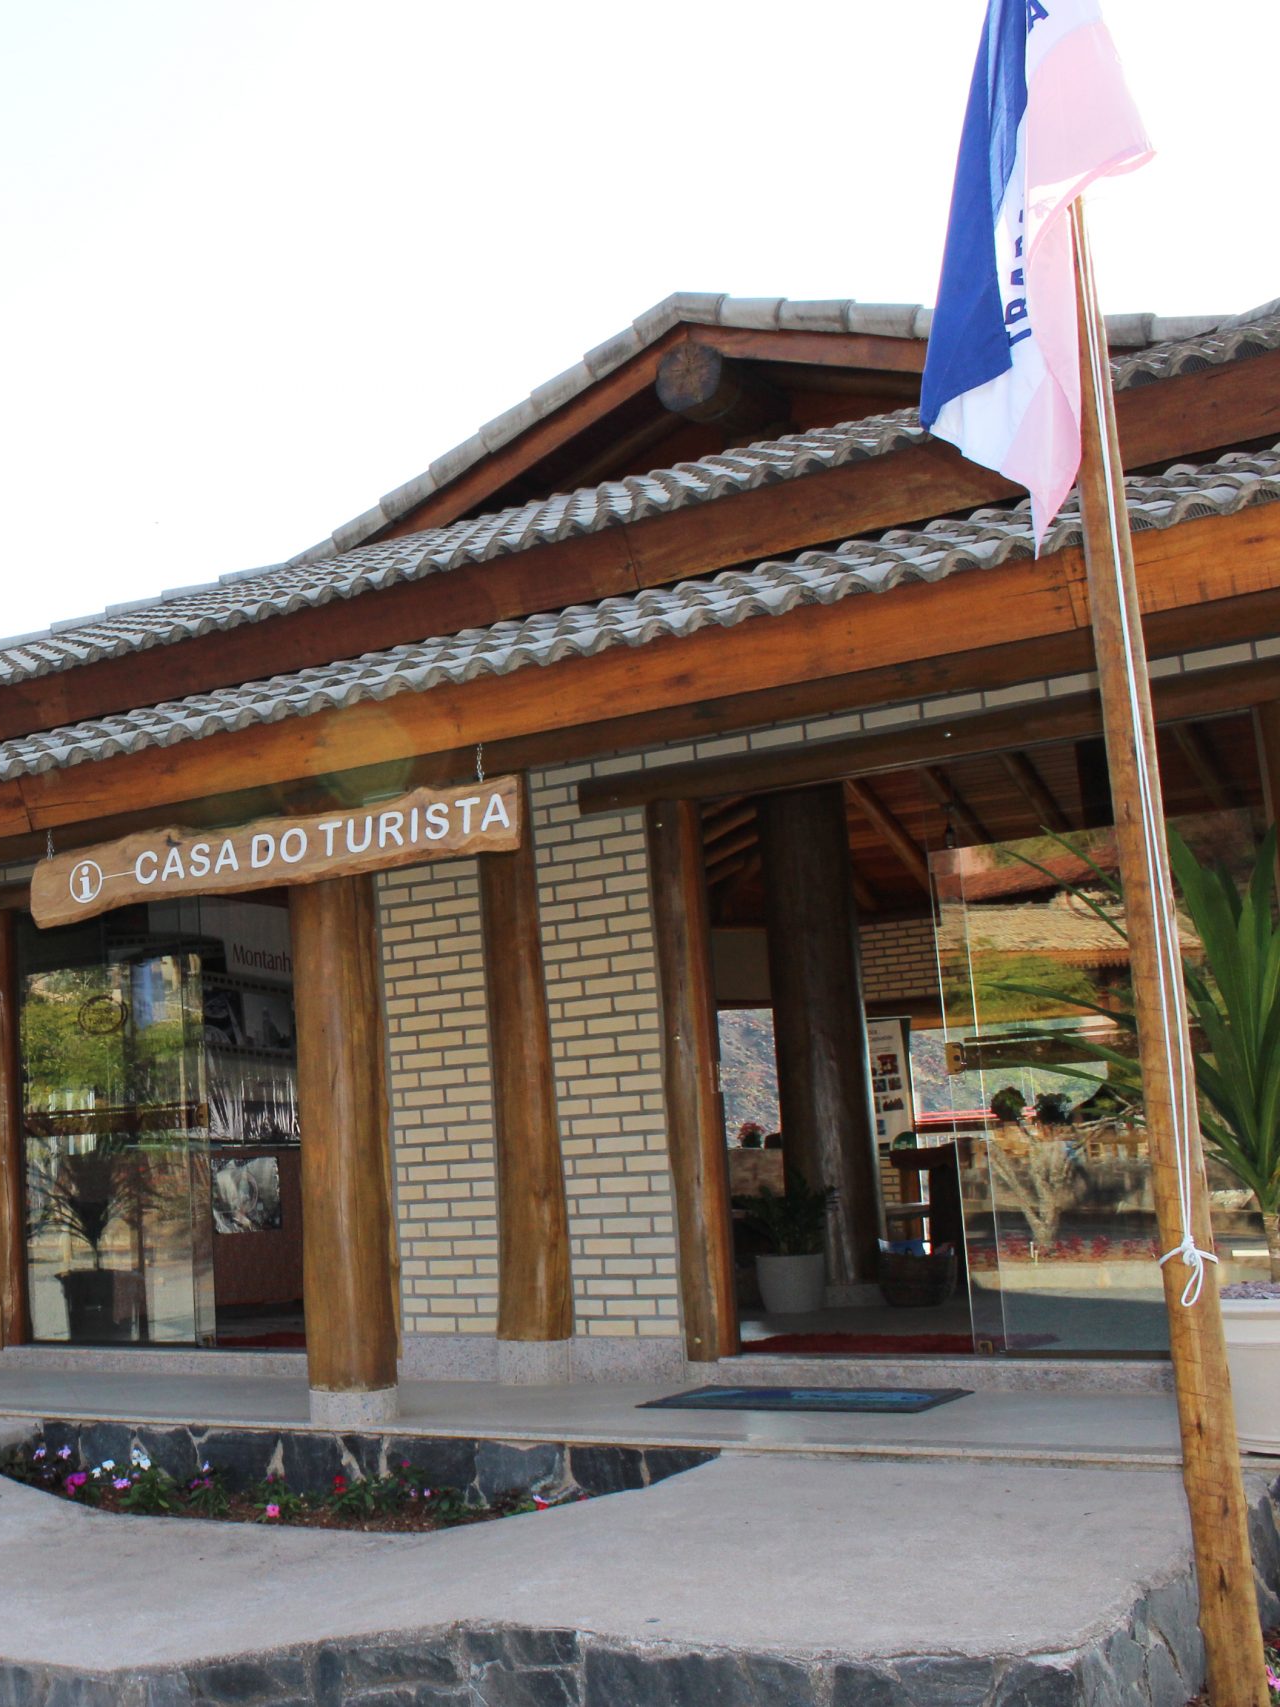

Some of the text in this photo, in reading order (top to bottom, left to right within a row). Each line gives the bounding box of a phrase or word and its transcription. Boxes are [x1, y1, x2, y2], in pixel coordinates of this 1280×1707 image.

[134, 792, 511, 885] CASA DO TURISTA
